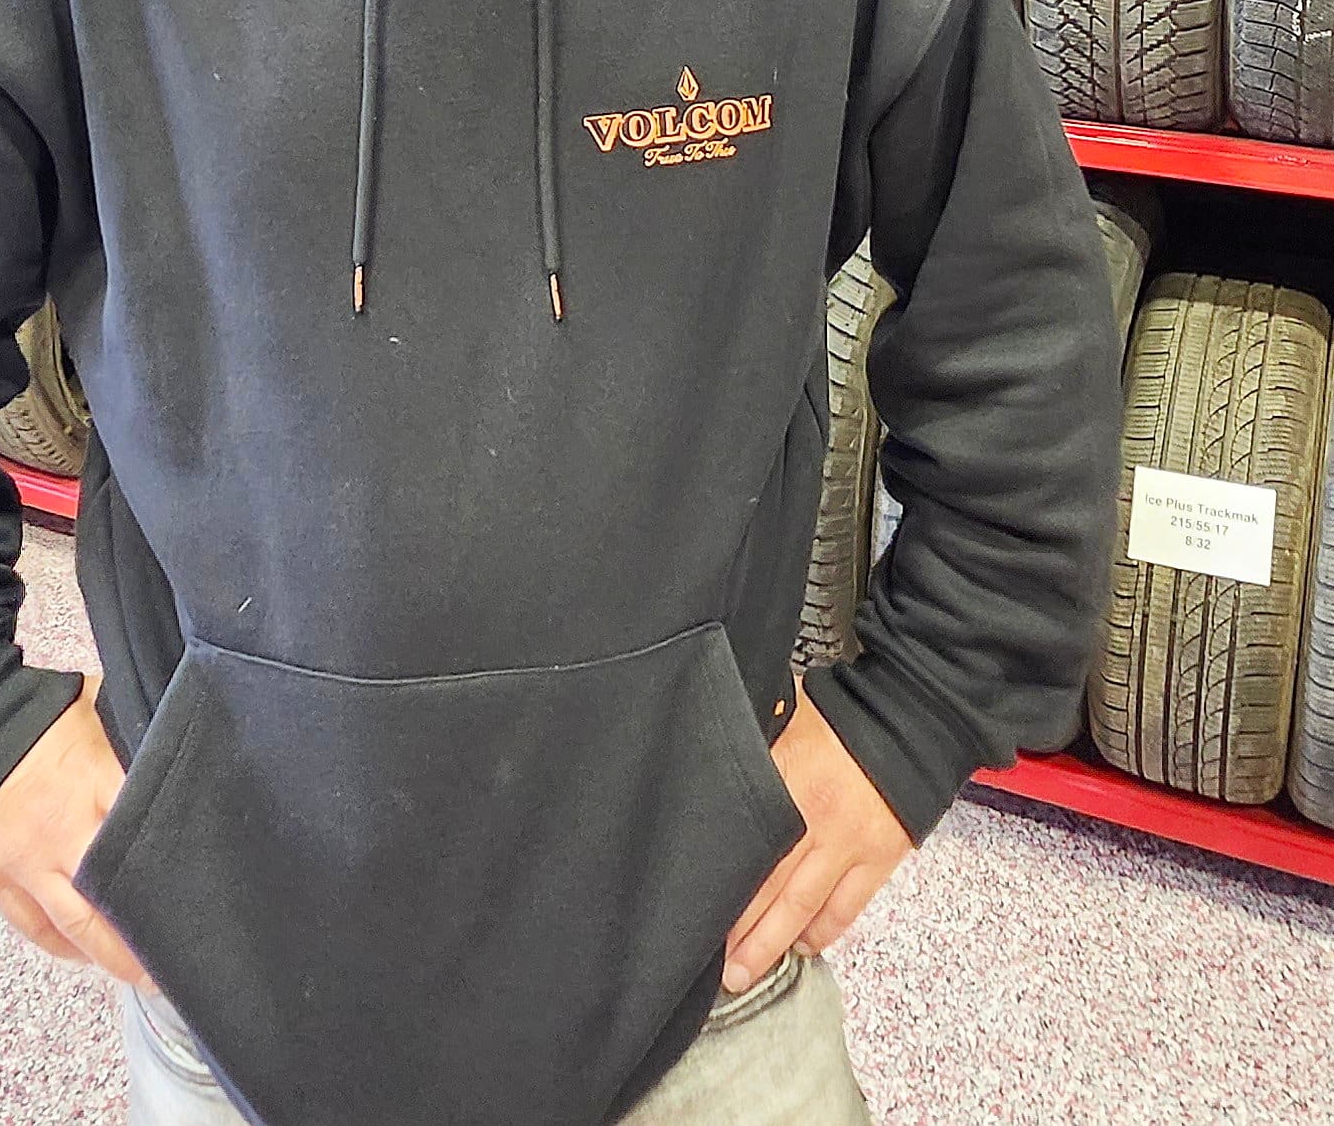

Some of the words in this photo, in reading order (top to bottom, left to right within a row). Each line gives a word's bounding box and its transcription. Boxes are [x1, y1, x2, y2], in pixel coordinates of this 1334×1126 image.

[583, 93, 773, 152] VOLCOM
[1145, 493, 1162, 507] Ice
[1166, 497, 1193, 513] Plus
[1197, 503, 1259, 525] Trackmak
